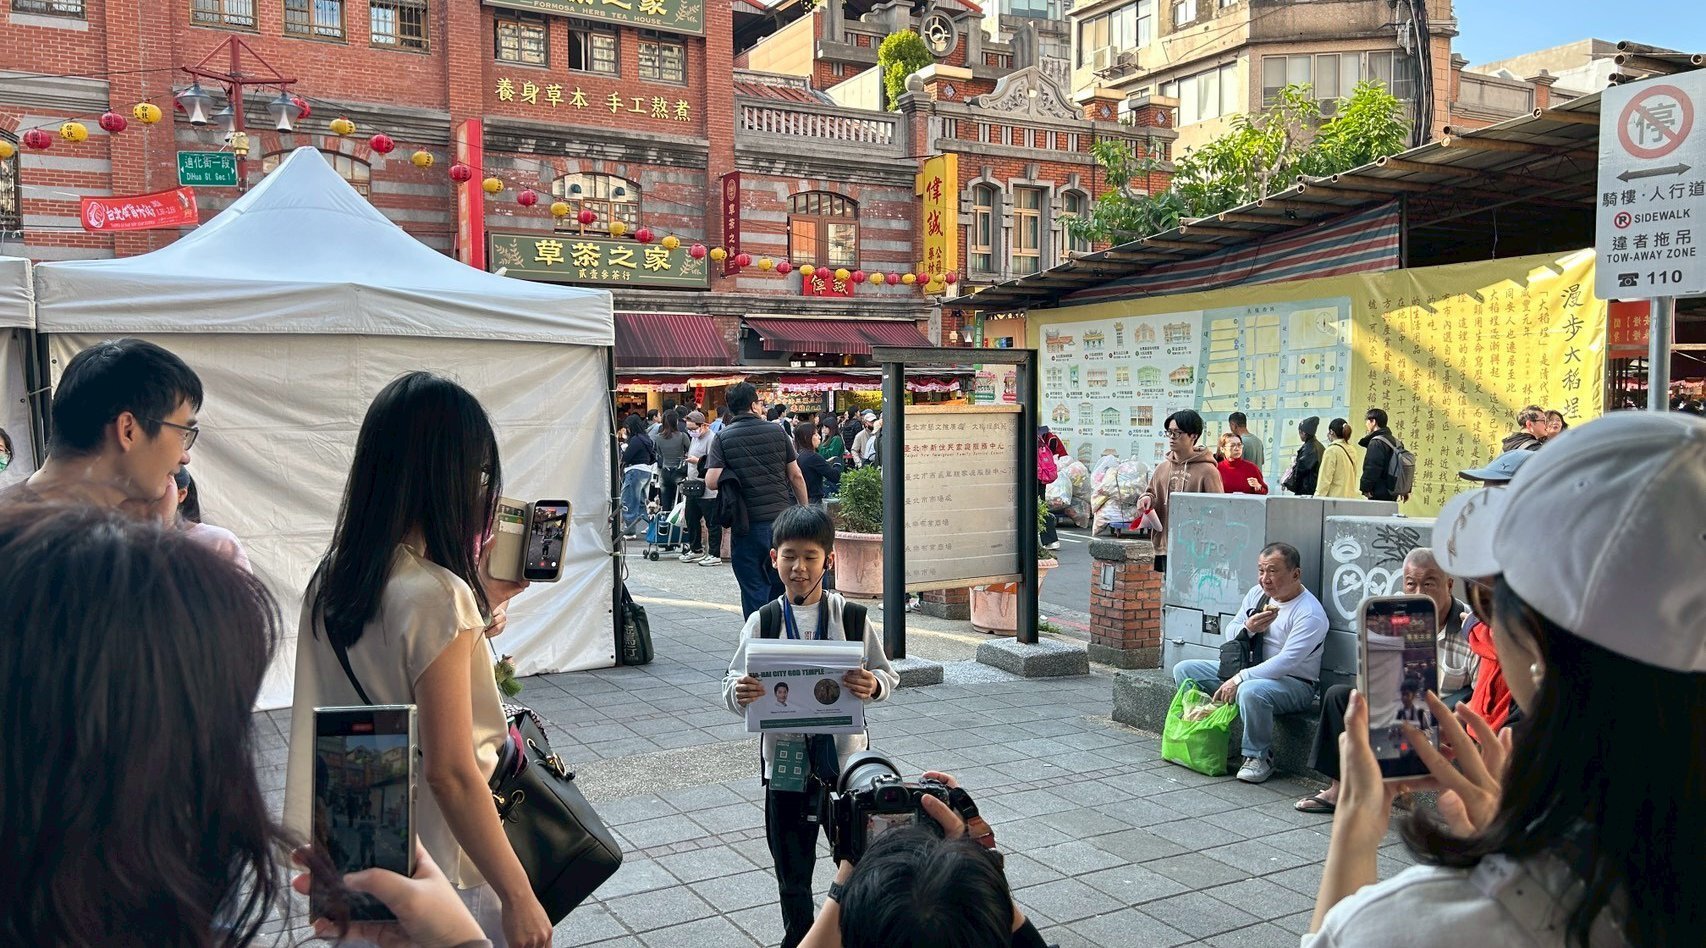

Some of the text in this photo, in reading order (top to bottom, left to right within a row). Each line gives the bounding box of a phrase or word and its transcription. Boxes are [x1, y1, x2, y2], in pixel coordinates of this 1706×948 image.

[534, 0, 576, 12] FORMOSA
[582, 8, 606, 17] HERB
[611, 12, 628, 20] TEA
[633, 15, 663, 25] HOUSE
[494, 77, 692, 122] 養身草本 手工熬煮
[184, 155, 231, 169] 迪化街一段
[926, 175, 944, 237] 偉誠
[1634, 208, 1691, 224] SIDEWALK
[1612, 229, 1692, 251] 違者拖吊
[534, 239, 672, 271] 草茶之家
[1606, 246, 1696, 264] TOW-AWAY ZONE
[810, 275, 849, 295] 偉誠
[1647, 269, 1683, 285] 110
[1560, 283, 1585, 420] 漫步大稻埕
[772, 669, 787, 678] CITY
[801, 667, 825, 677] TEMPLE
